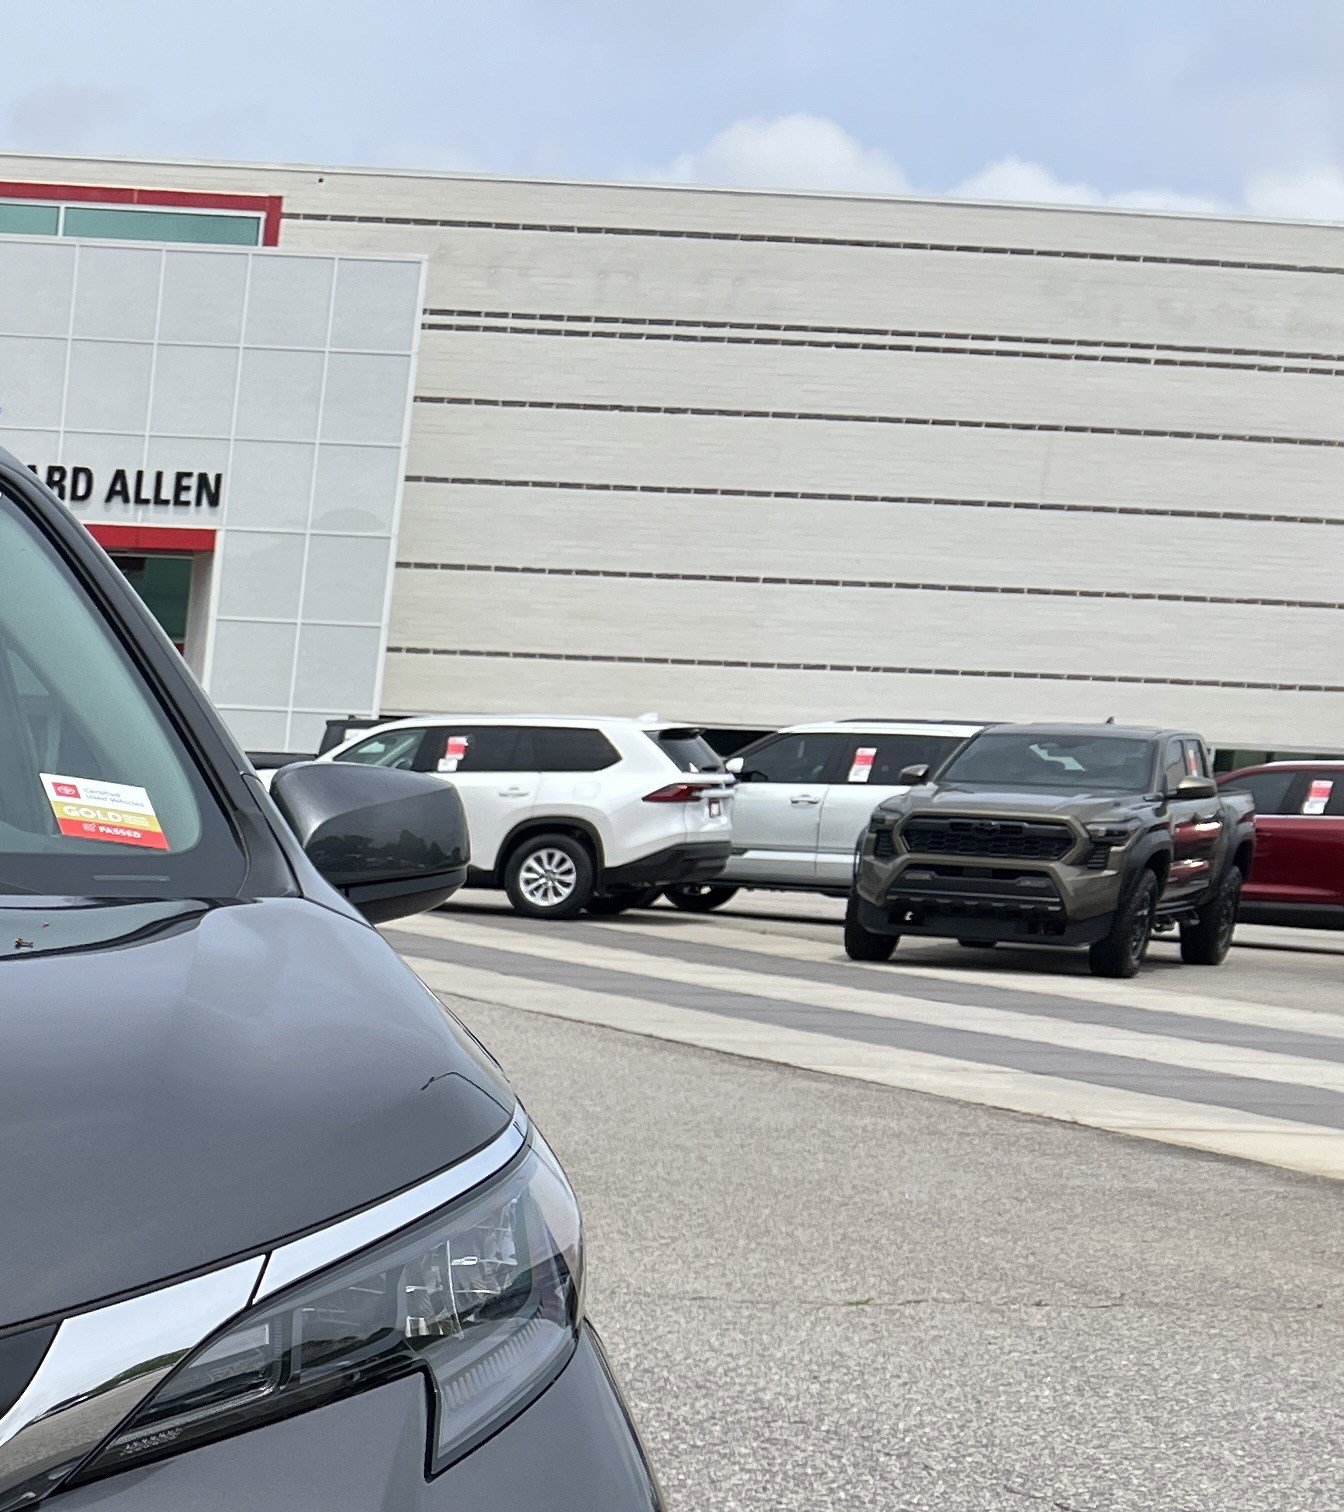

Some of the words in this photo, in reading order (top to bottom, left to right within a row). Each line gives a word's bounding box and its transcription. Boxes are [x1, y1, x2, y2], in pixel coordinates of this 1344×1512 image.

[27, 464, 94, 501] RD
[104, 469, 223, 507] ALLEN
[62, 805, 123, 823] GOLD
[98, 824, 142, 838] PASSED
